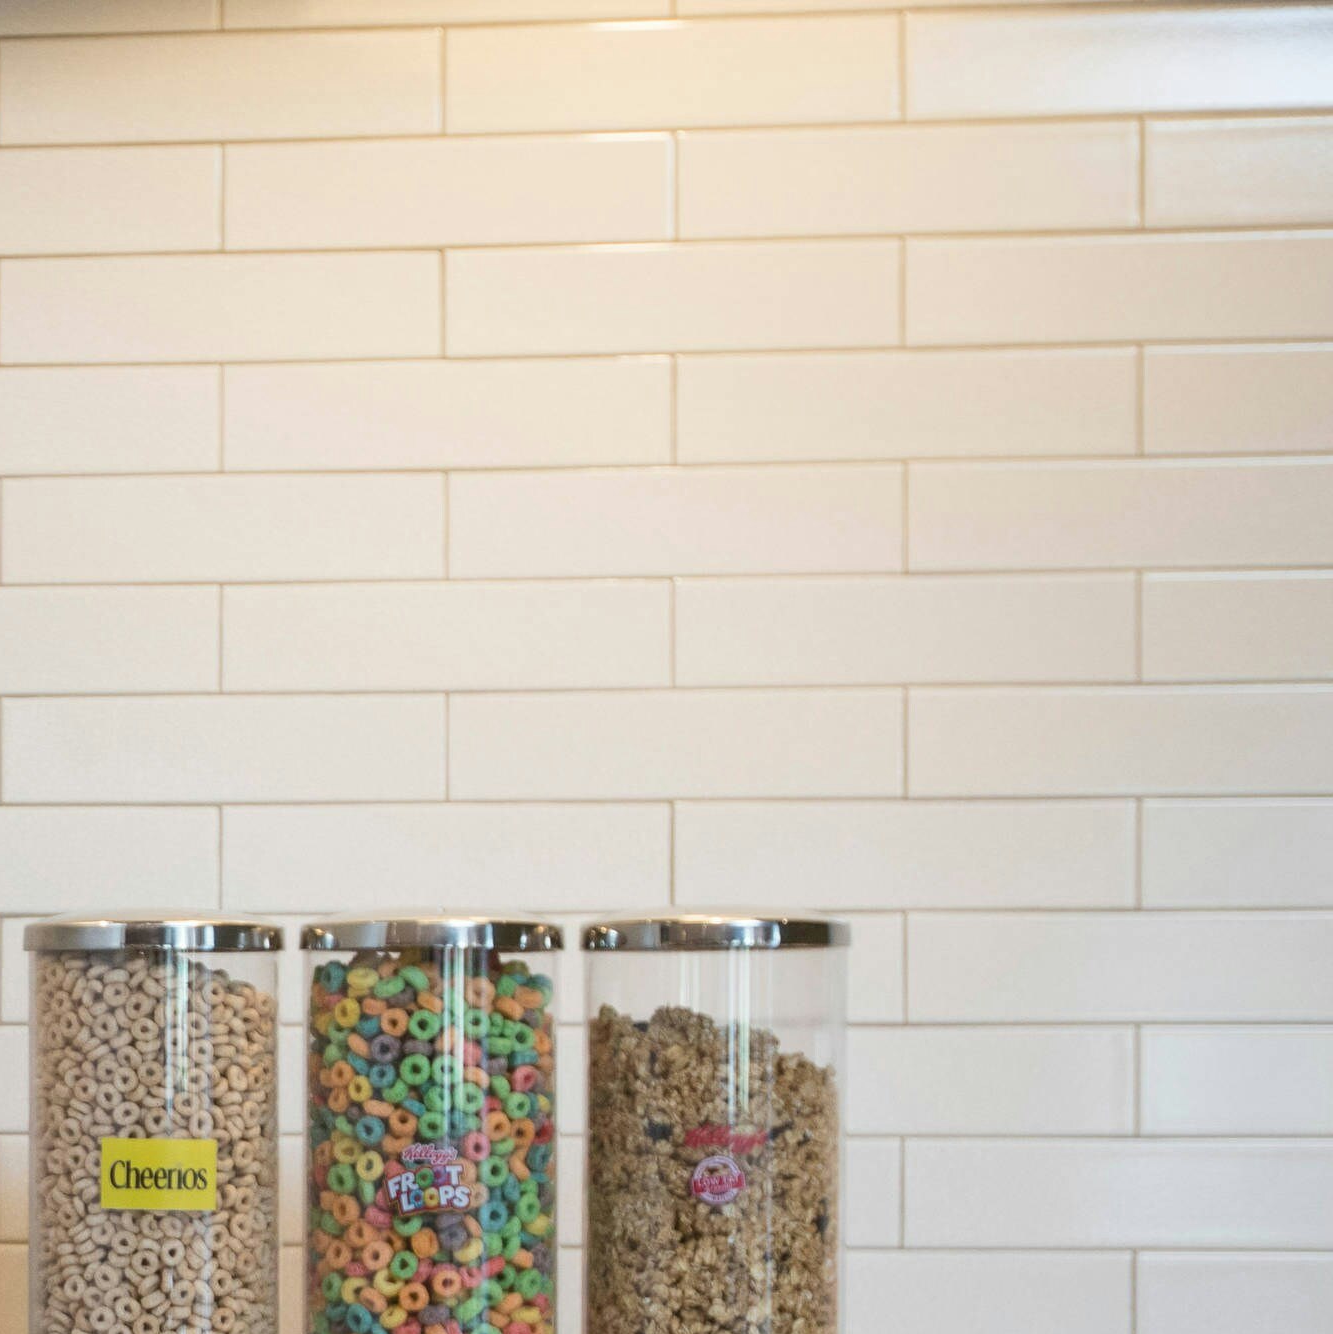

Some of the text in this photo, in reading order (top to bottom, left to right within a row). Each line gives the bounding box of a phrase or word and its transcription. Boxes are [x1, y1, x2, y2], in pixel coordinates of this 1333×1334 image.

[110, 1160, 208, 1190] Cheerios
[388, 1165, 463, 1199] FROOT
[401, 1186, 470, 1212] LOOPS
